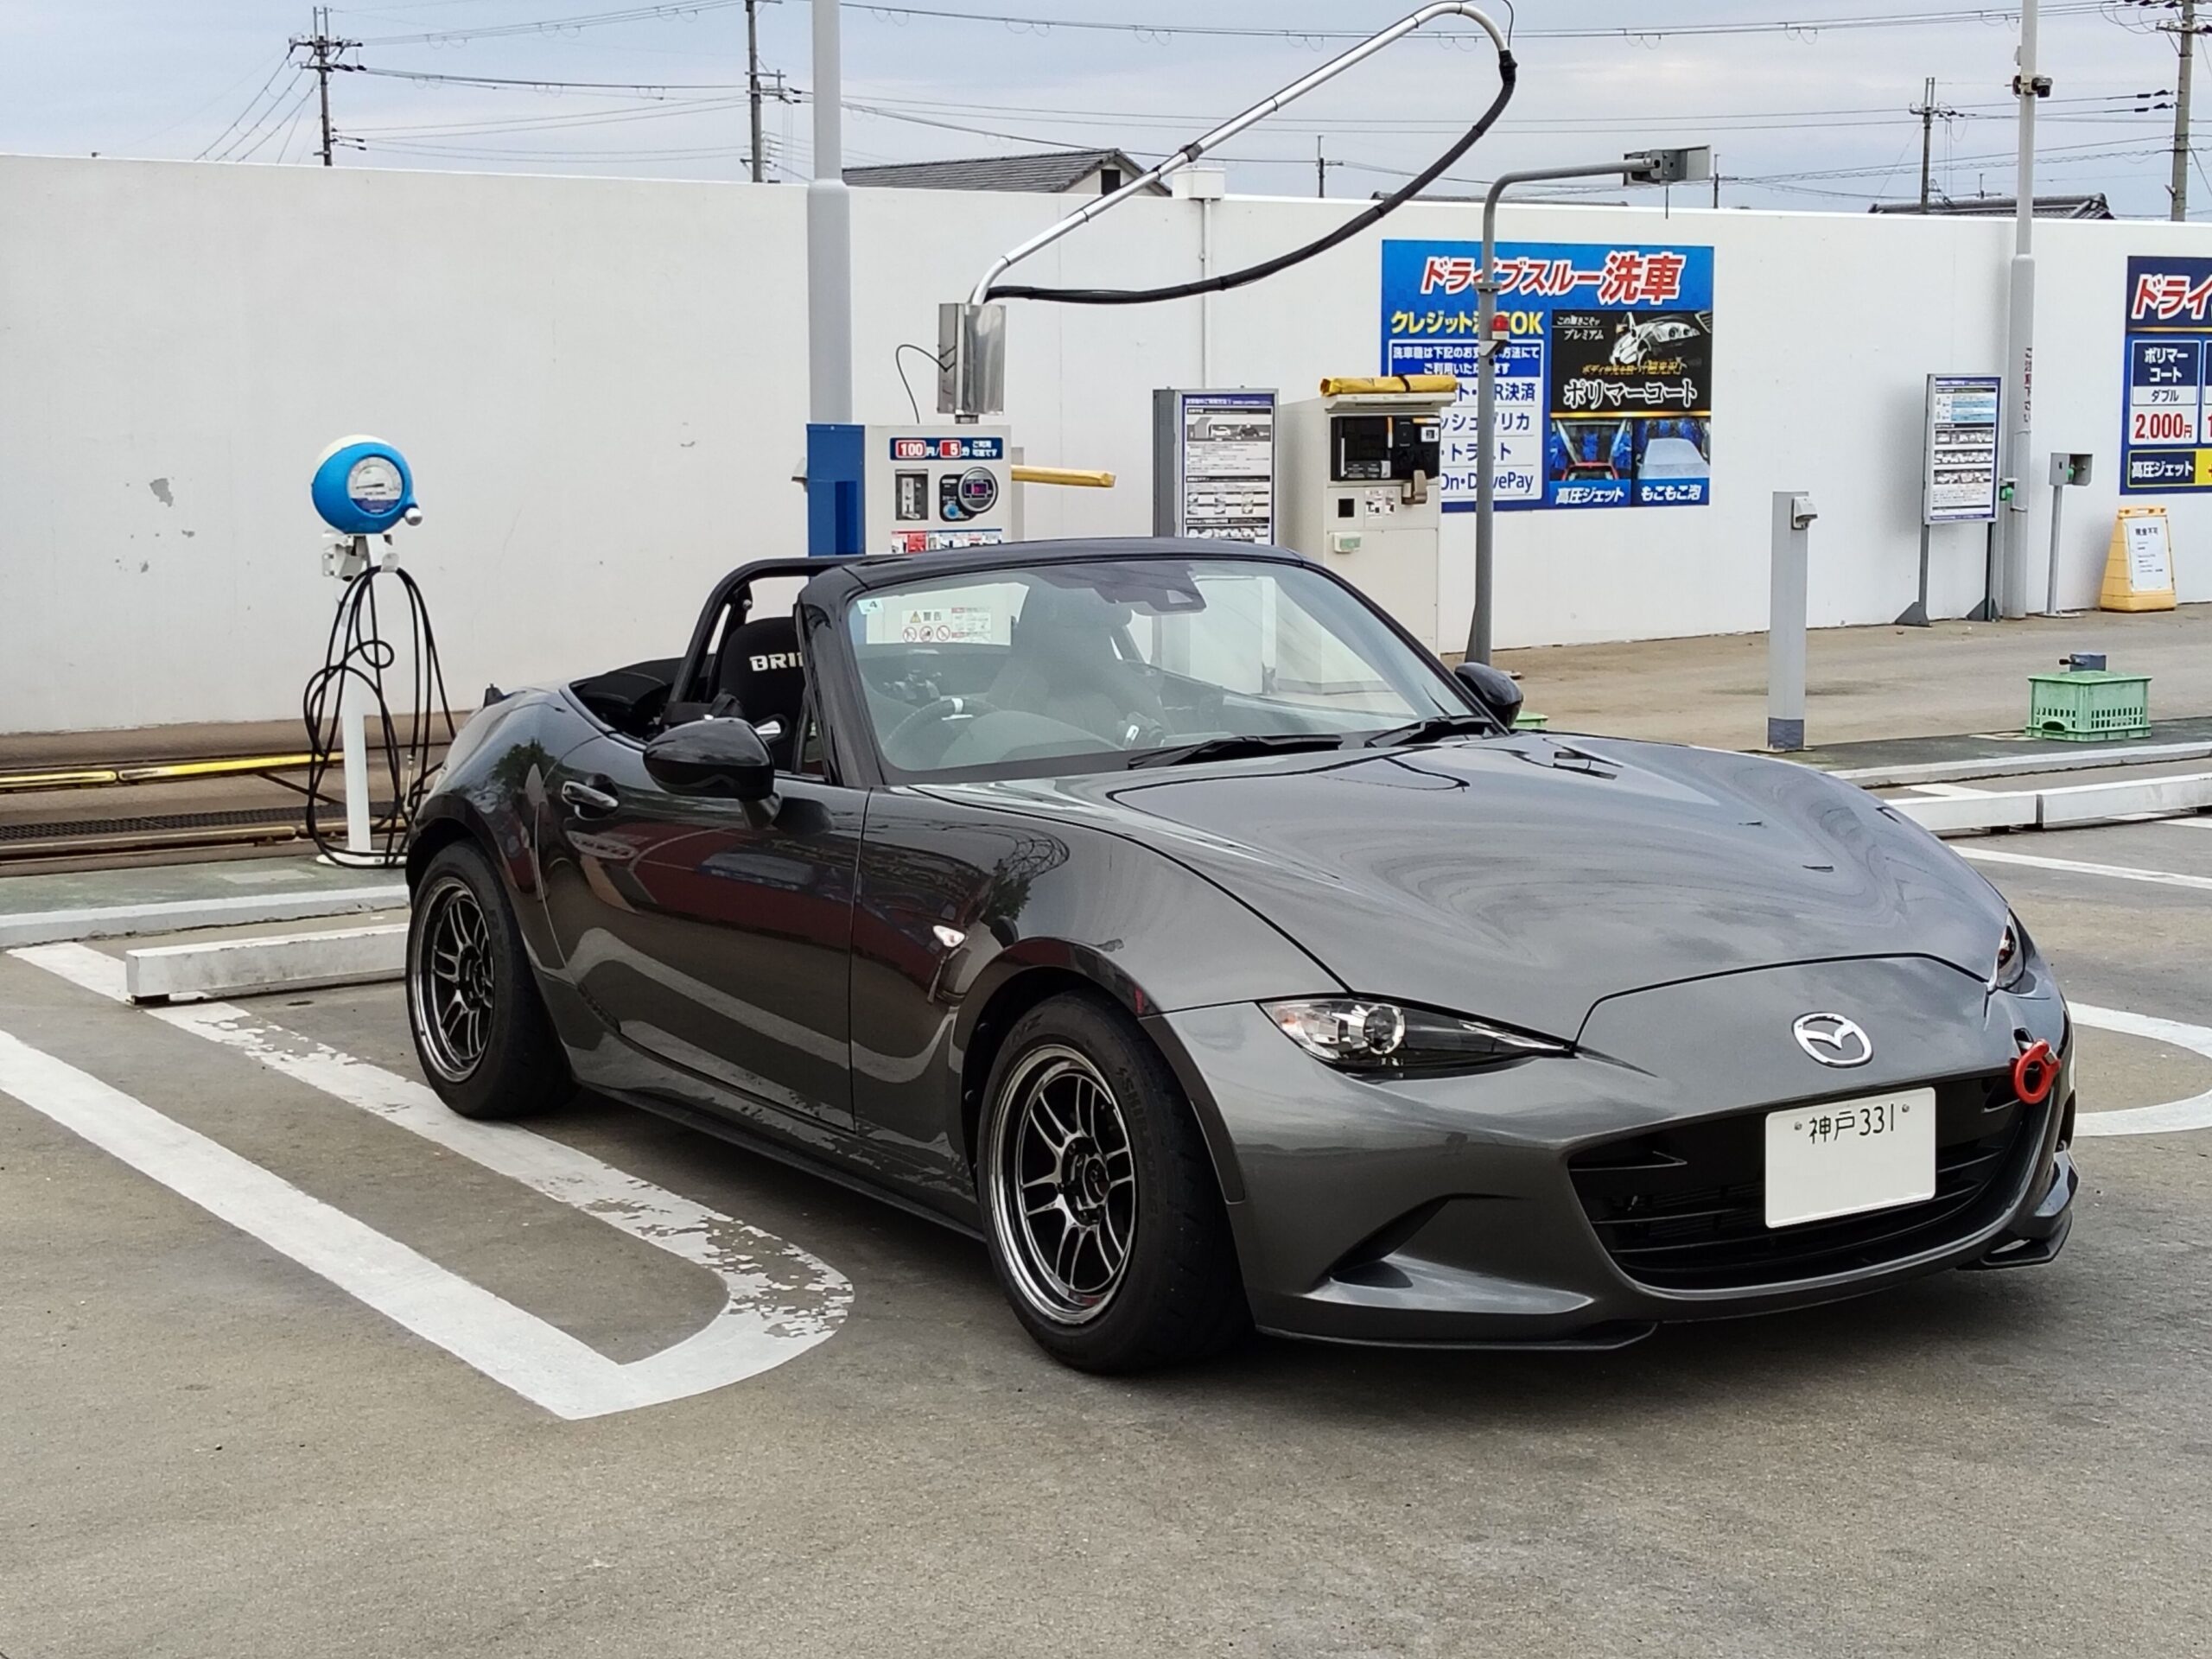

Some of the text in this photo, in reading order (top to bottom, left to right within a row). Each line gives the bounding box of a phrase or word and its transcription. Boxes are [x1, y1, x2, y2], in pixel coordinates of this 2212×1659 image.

[2131, 274, 2212, 319] ドライ
[1391, 310, 1544, 334] クレジットOK
[2145, 347, 2189, 363] ポリマー
[2149, 366, 2183, 383] コート
[1459, 382, 1535, 402] ト・R決済
[1564, 378, 1697, 409] ポリマーコート
[2152, 390, 2179, 403] ダブル
[2132, 461, 2194, 479] 高圧ジェット
[1556, 486, 1624, 505] 高圧ジェット
[1642, 485, 1702, 502] もこもこ泡
